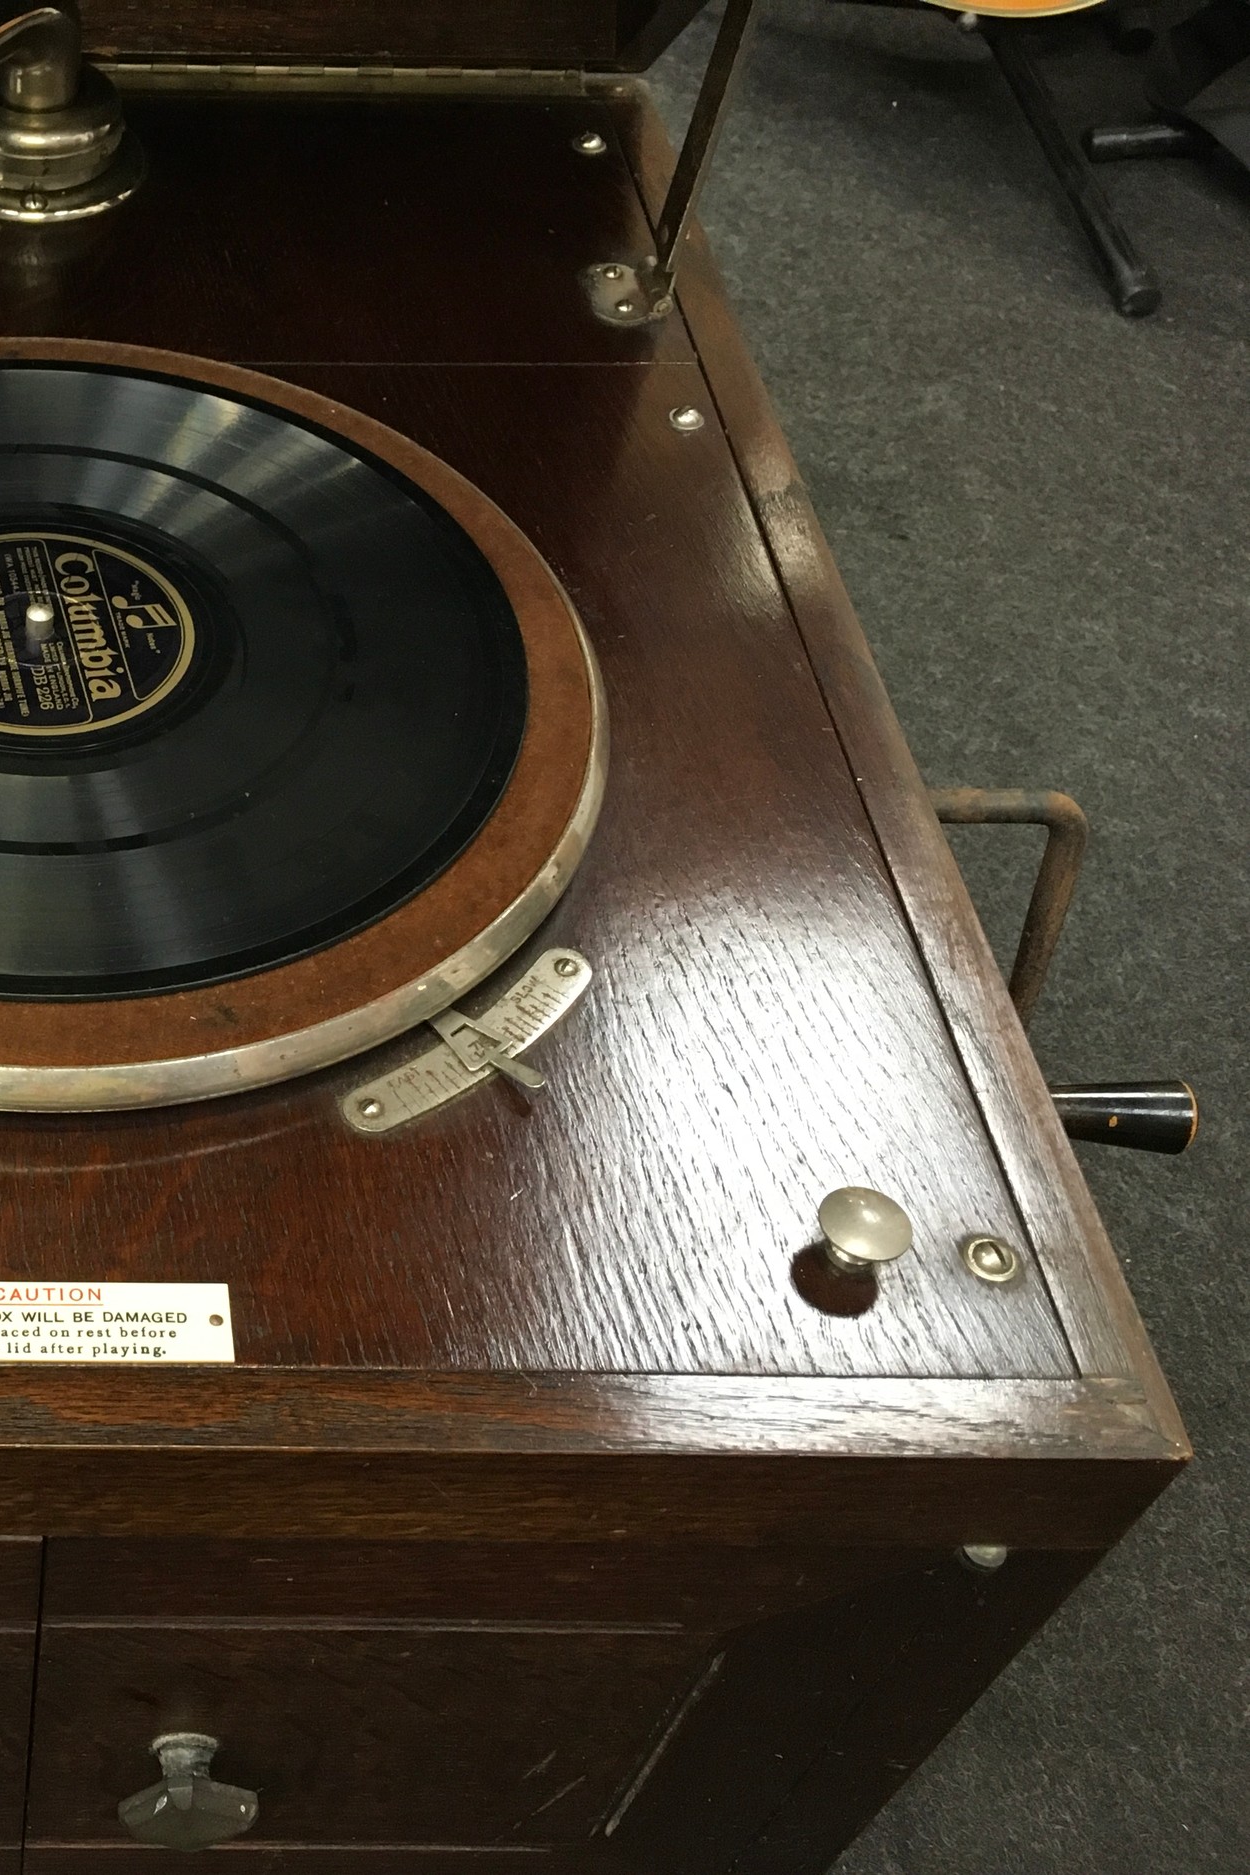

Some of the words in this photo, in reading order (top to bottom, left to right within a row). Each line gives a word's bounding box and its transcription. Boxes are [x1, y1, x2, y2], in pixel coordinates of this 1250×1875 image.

[55, 551, 124, 702] Columbia
[31, 666, 47, 686] DB
[41, 643, 50, 663] MADE
[49, 674, 63, 710] ENGLAND
[37, 686, 53, 710] 226
[21, 1311, 65, 1323] WILL
[73, 1311, 94, 1323] BE
[102, 1311, 188, 1324] DAMAGED
[49, 1329, 70, 1338] on
[77, 1328, 111, 1338] rest
[119, 1326, 177, 1338] before
[7, 1342, 31, 1354] lid
[40, 1342, 84, 1355] after
[92, 1343, 167, 1358] playing.
